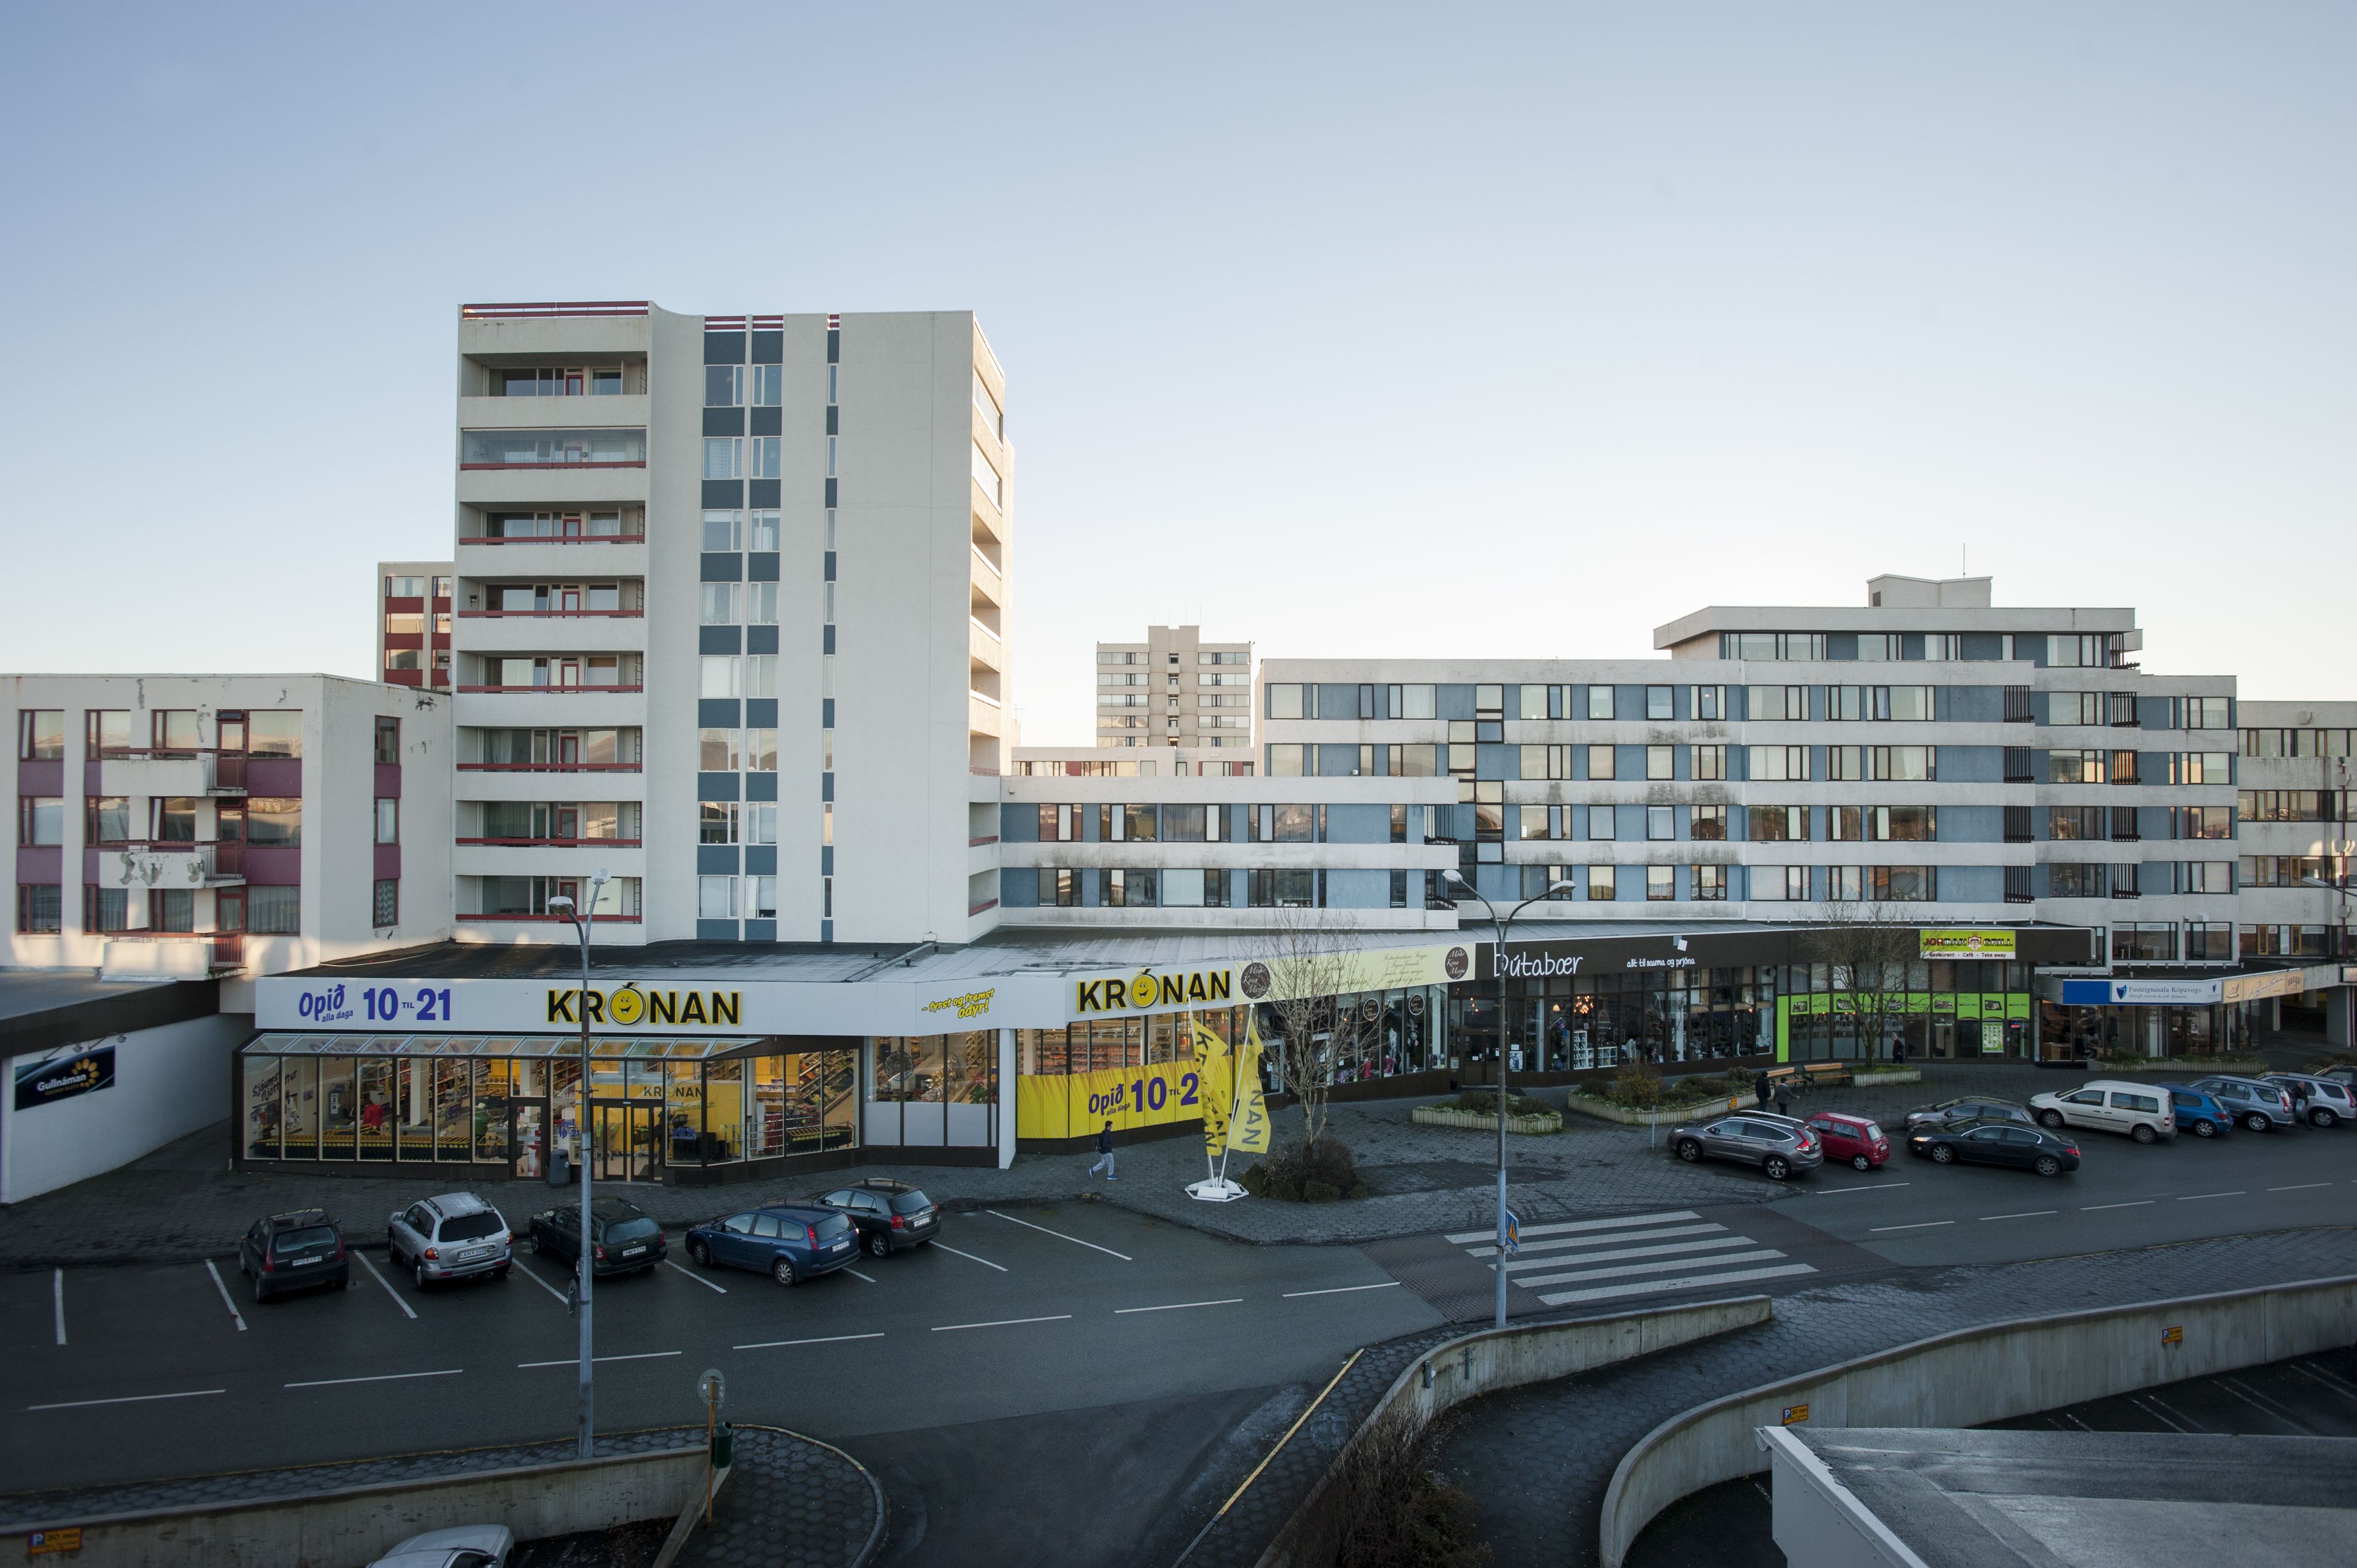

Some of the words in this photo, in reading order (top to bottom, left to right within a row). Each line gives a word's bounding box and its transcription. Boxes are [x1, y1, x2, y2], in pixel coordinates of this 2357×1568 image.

[1924, 938, 1967, 946] JORDAN
[1983, 938, 2013, 946] GRILL
[1627, 958, 1638, 967] allt
[1667, 959, 1674, 968] og
[1676, 957, 1695, 967] prjóna
[1077, 966, 1231, 1013] KRÓNAN
[2171, 986, 2202, 994] Kópavogs
[299, 984, 346, 1021] Opið
[363, 987, 398, 1021] 10
[416, 987, 451, 1021] 21
[547, 981, 741, 1026] KRÓNAN
[929, 1001, 952, 1013] fyrst
[953, 996, 964, 1008] og
[965, 987, 995, 1004] fremst
[958, 998, 989, 1019] ódýr!
[321, 1013, 335, 1022] alla
[336, 1010, 354, 1020] daga
[37, 1074, 87, 1092] Gullnáman
[1088, 1083, 1124, 1116] Opið
[1131, 1076, 1167, 1113] 10
[1106, 1106, 1117, 1116] alla
[1117, 1102, 1131, 1113] daga
[558, 1129, 568, 1137] 10
[571, 1129, 580, 1137] 21
